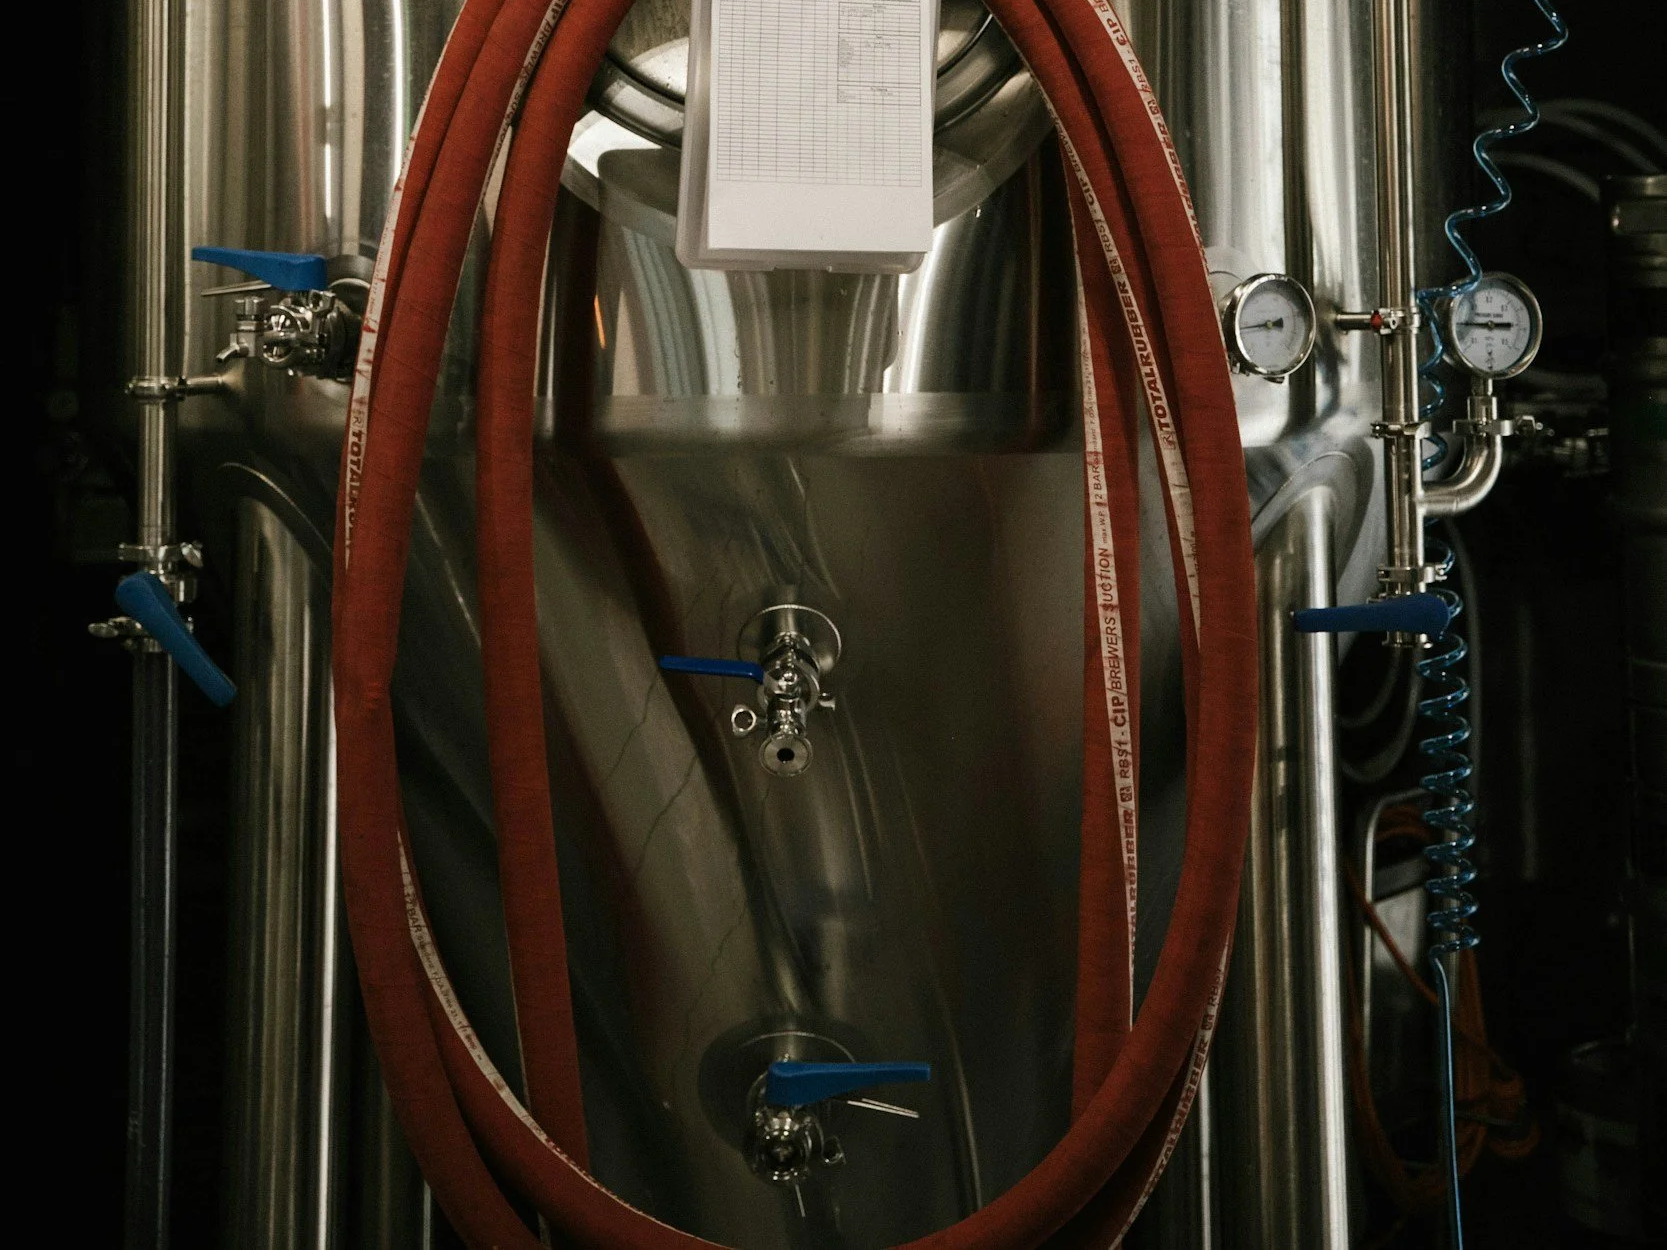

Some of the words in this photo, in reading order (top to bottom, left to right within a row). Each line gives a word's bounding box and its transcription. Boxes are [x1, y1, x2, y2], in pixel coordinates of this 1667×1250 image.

[1107, 18, 1128, 45] CIP
[1119, 281, 1170, 432] TOTALRUBBER
[1092, 464, 1103, 491] BAR
[1098, 547, 1114, 612] SUCTION
[1105, 616, 1122, 690] BREWERS
[1111, 695, 1126, 727] CIP
[1117, 741, 1131, 779] RBS1
[406, 907, 422, 933] BAR
